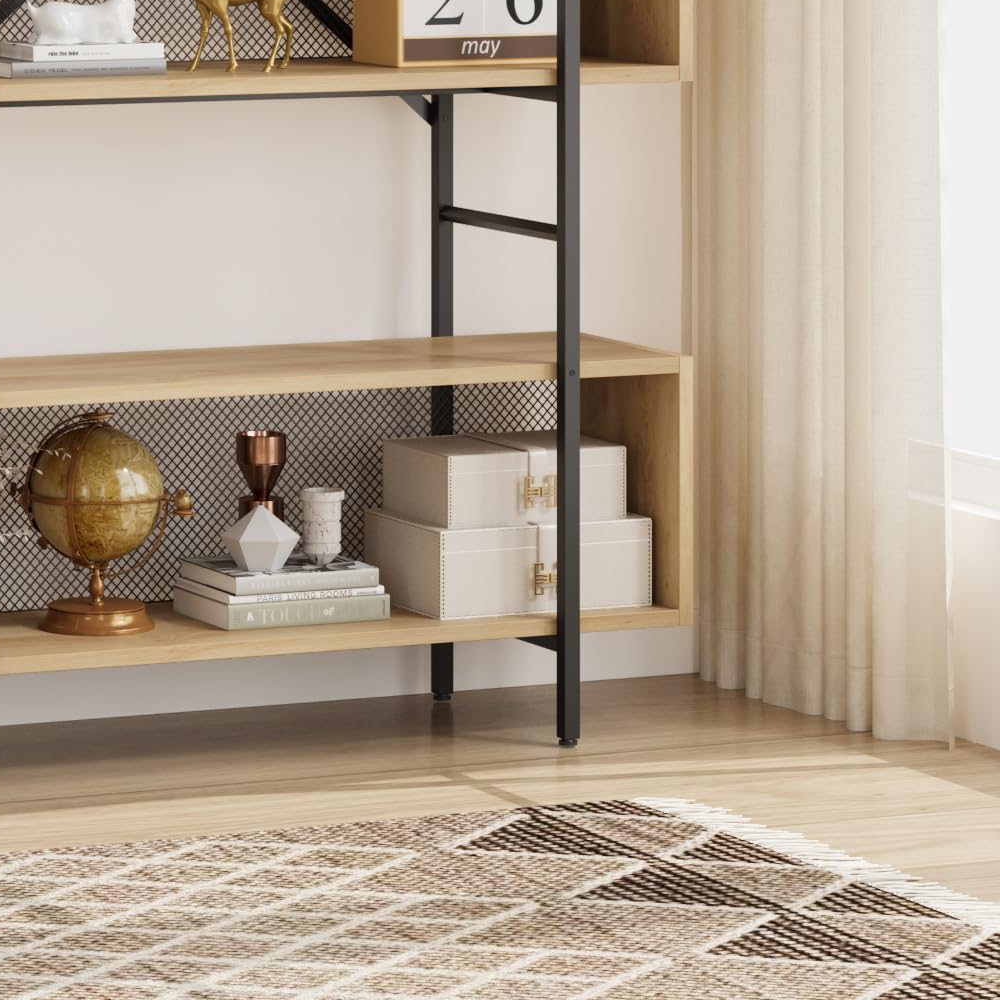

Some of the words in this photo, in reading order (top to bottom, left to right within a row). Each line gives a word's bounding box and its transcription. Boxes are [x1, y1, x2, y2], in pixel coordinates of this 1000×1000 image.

[461, 38, 501, 58] may
[256, 594, 283, 602] PARIS
[287, 591, 316, 601] LIVING
[319, 589, 353, 598] ROOMS
